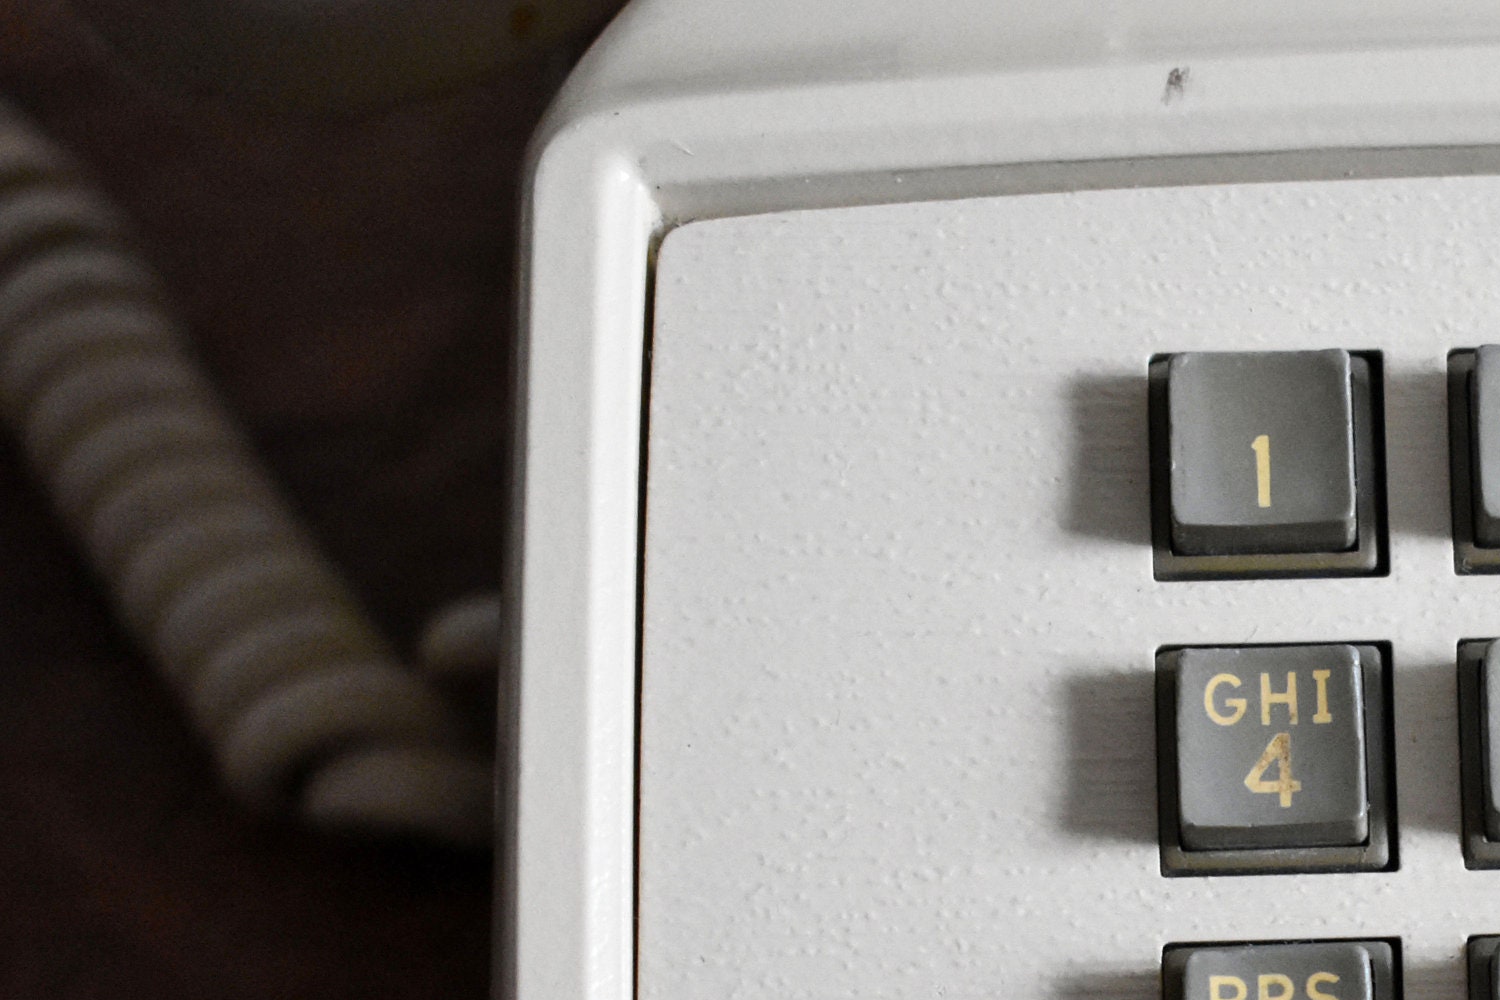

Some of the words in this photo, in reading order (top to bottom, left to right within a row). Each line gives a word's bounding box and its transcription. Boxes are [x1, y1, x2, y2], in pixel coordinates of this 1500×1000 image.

[1252, 435, 1271, 507] 1
[1205, 669, 1331, 725] GHI
[1245, 733, 1300, 807] 4
